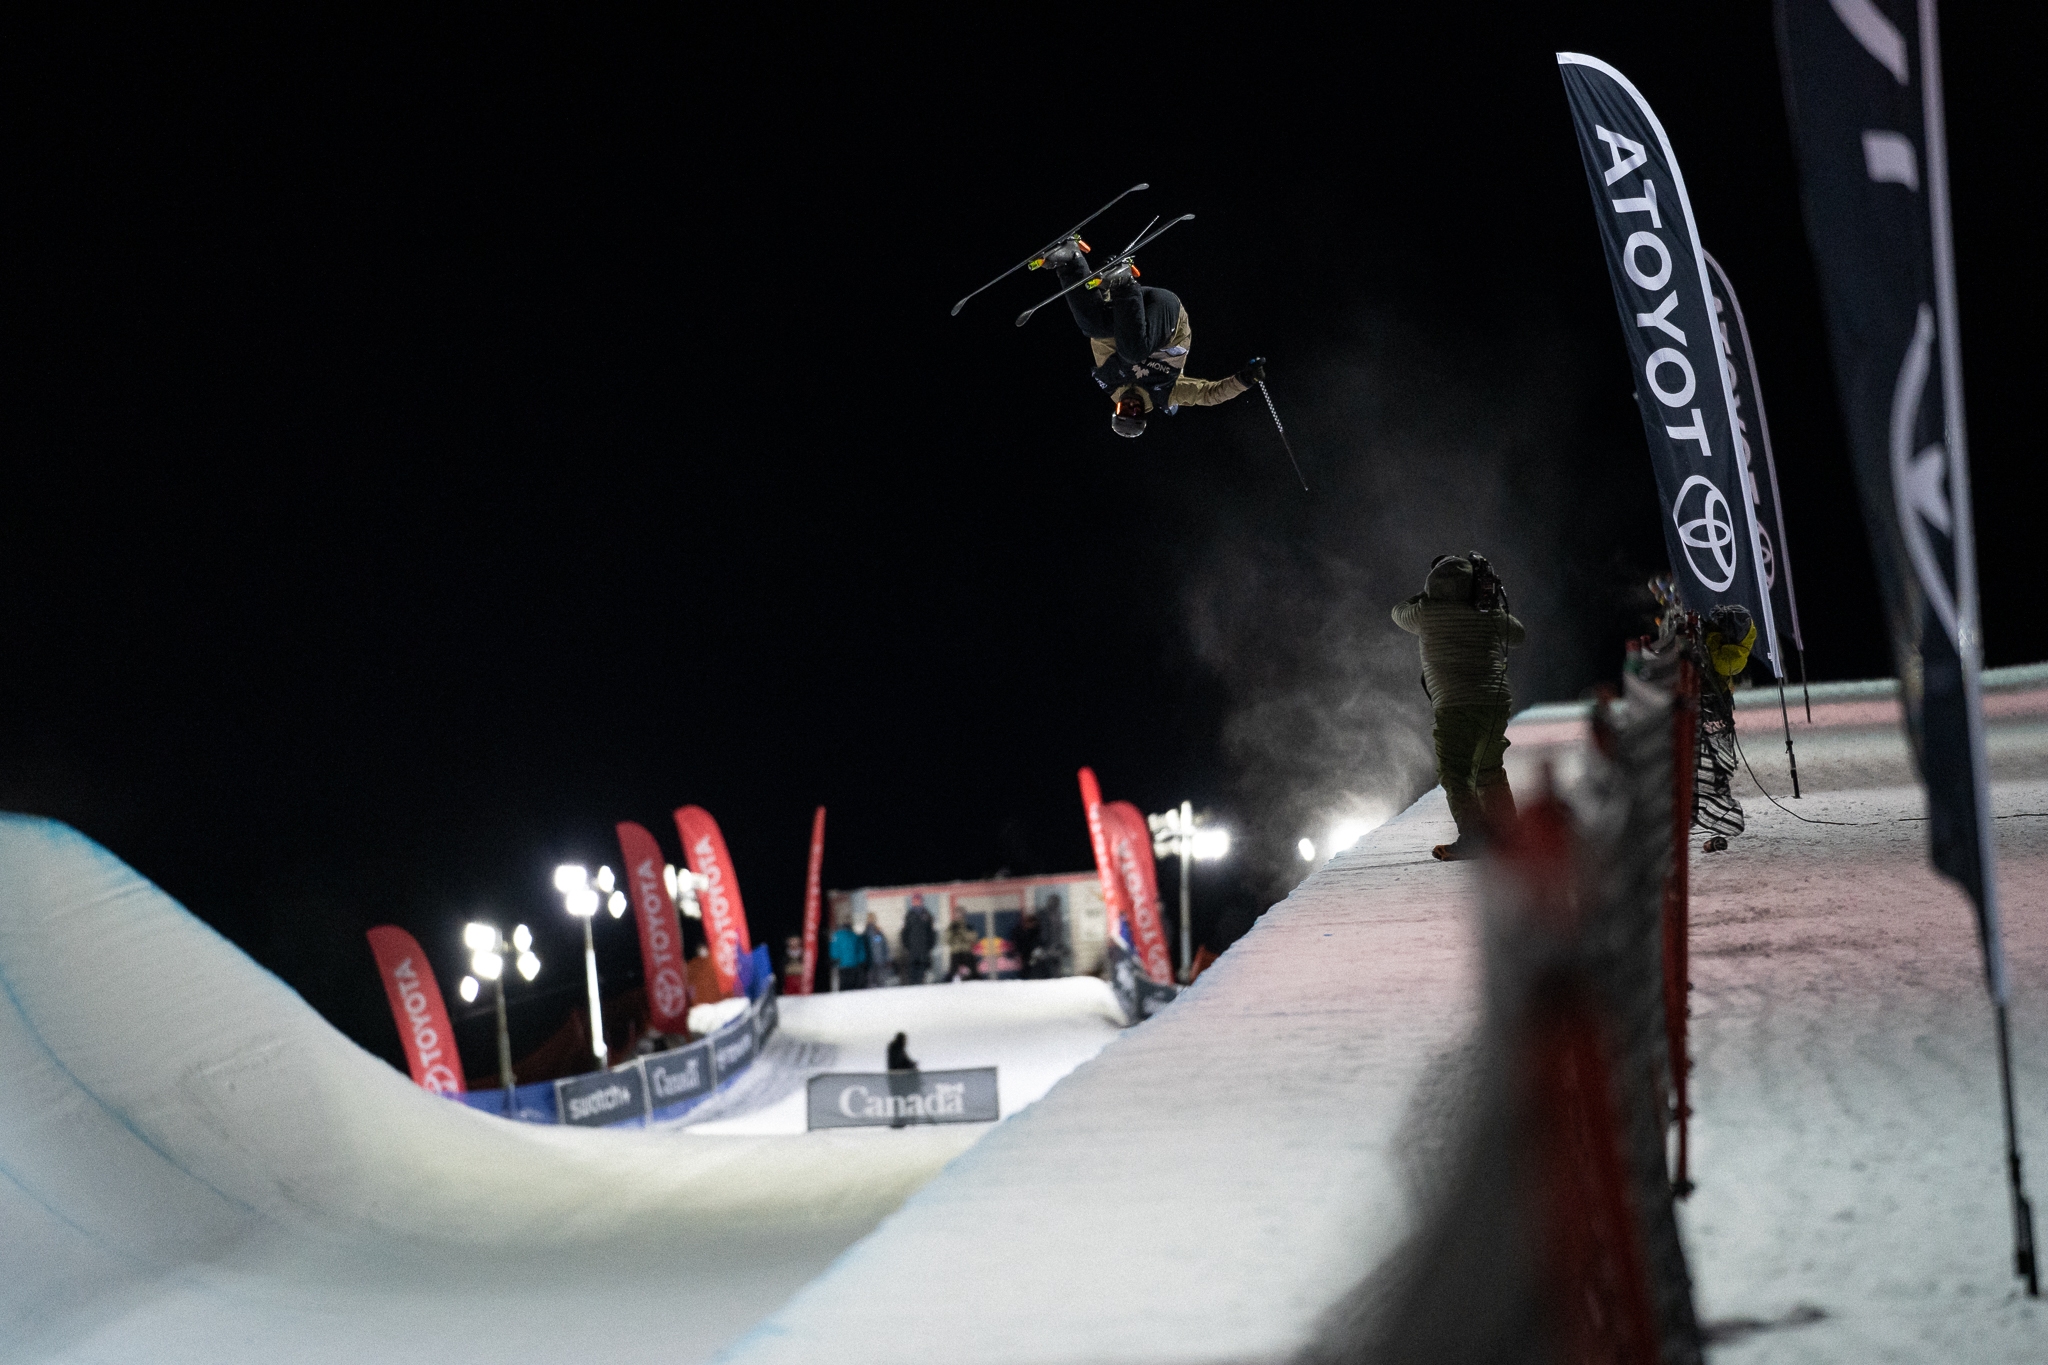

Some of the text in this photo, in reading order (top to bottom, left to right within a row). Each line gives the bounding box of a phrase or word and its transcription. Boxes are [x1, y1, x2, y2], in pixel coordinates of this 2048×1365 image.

[1146, 360, 1171, 374] SNOW
[637, 858, 673, 968] TOYOTA
[394, 957, 443, 1068] TOYOTA
[838, 1083, 966, 1119] Canada
